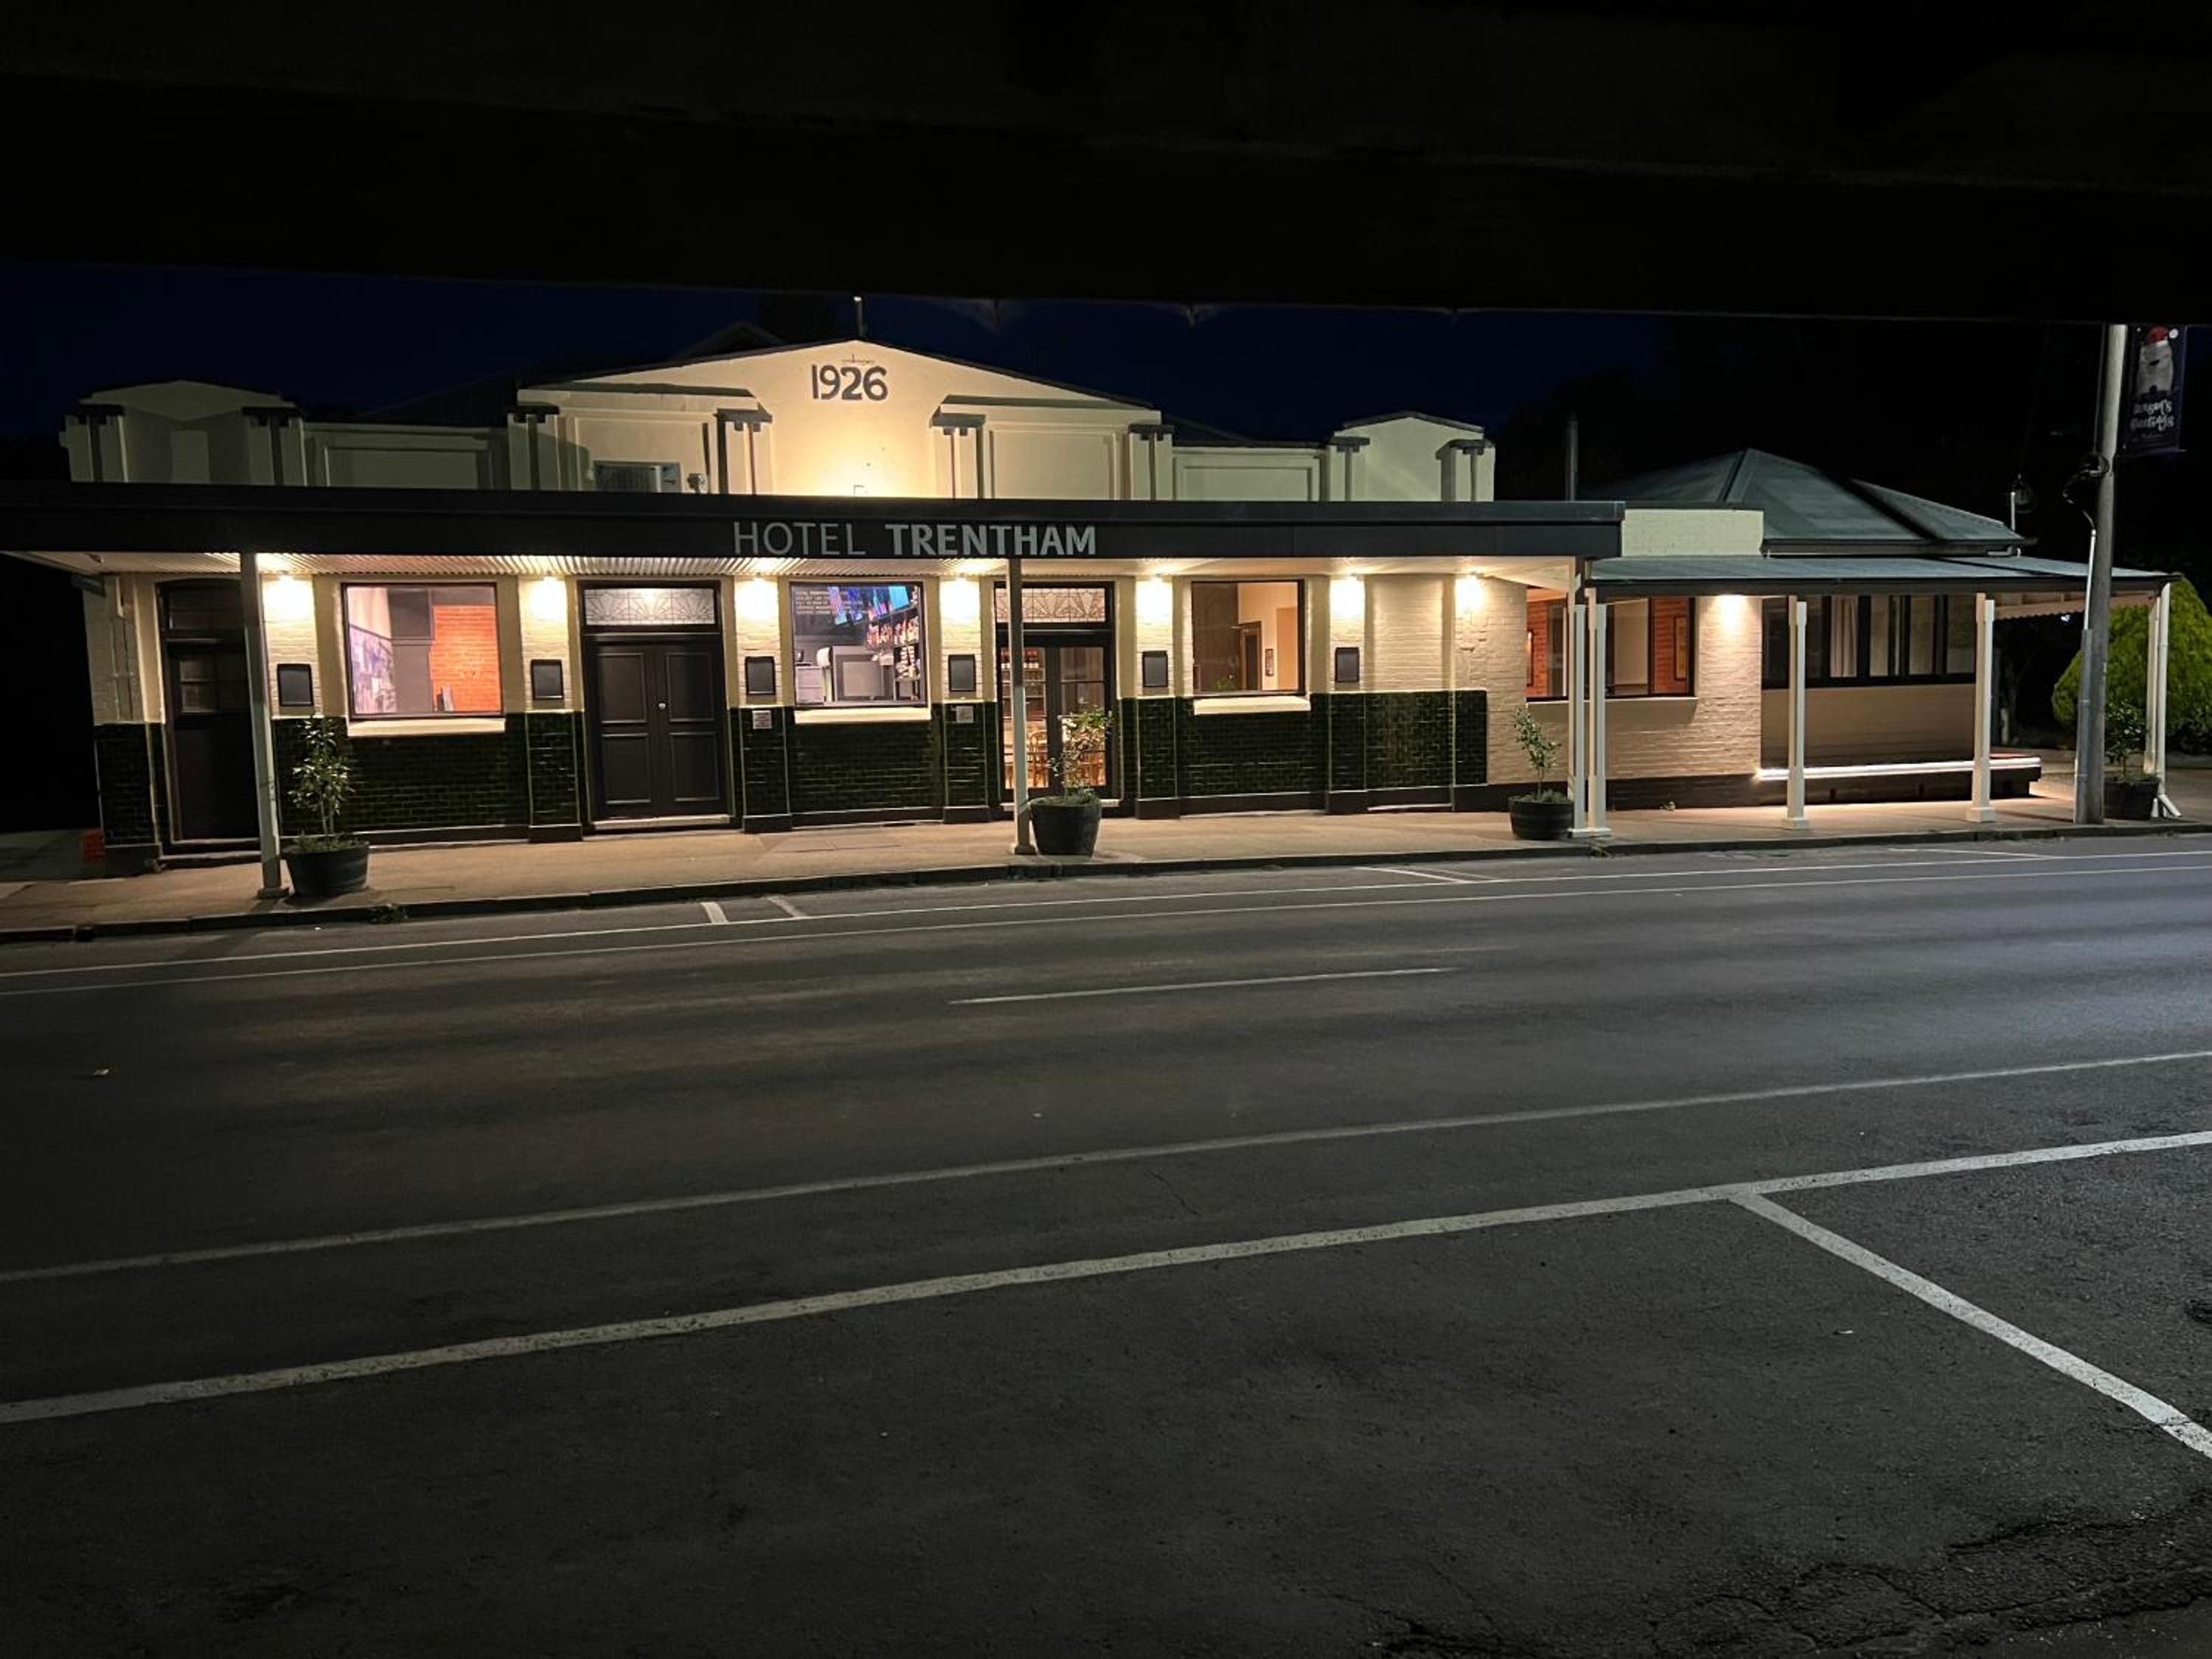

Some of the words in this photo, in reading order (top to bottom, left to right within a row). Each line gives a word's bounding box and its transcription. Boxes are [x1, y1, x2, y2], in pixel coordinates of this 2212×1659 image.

[812, 364, 888, 401] 1926
[734, 521, 866, 555] HOTEL
[885, 524, 1096, 555] TRENTHAM
